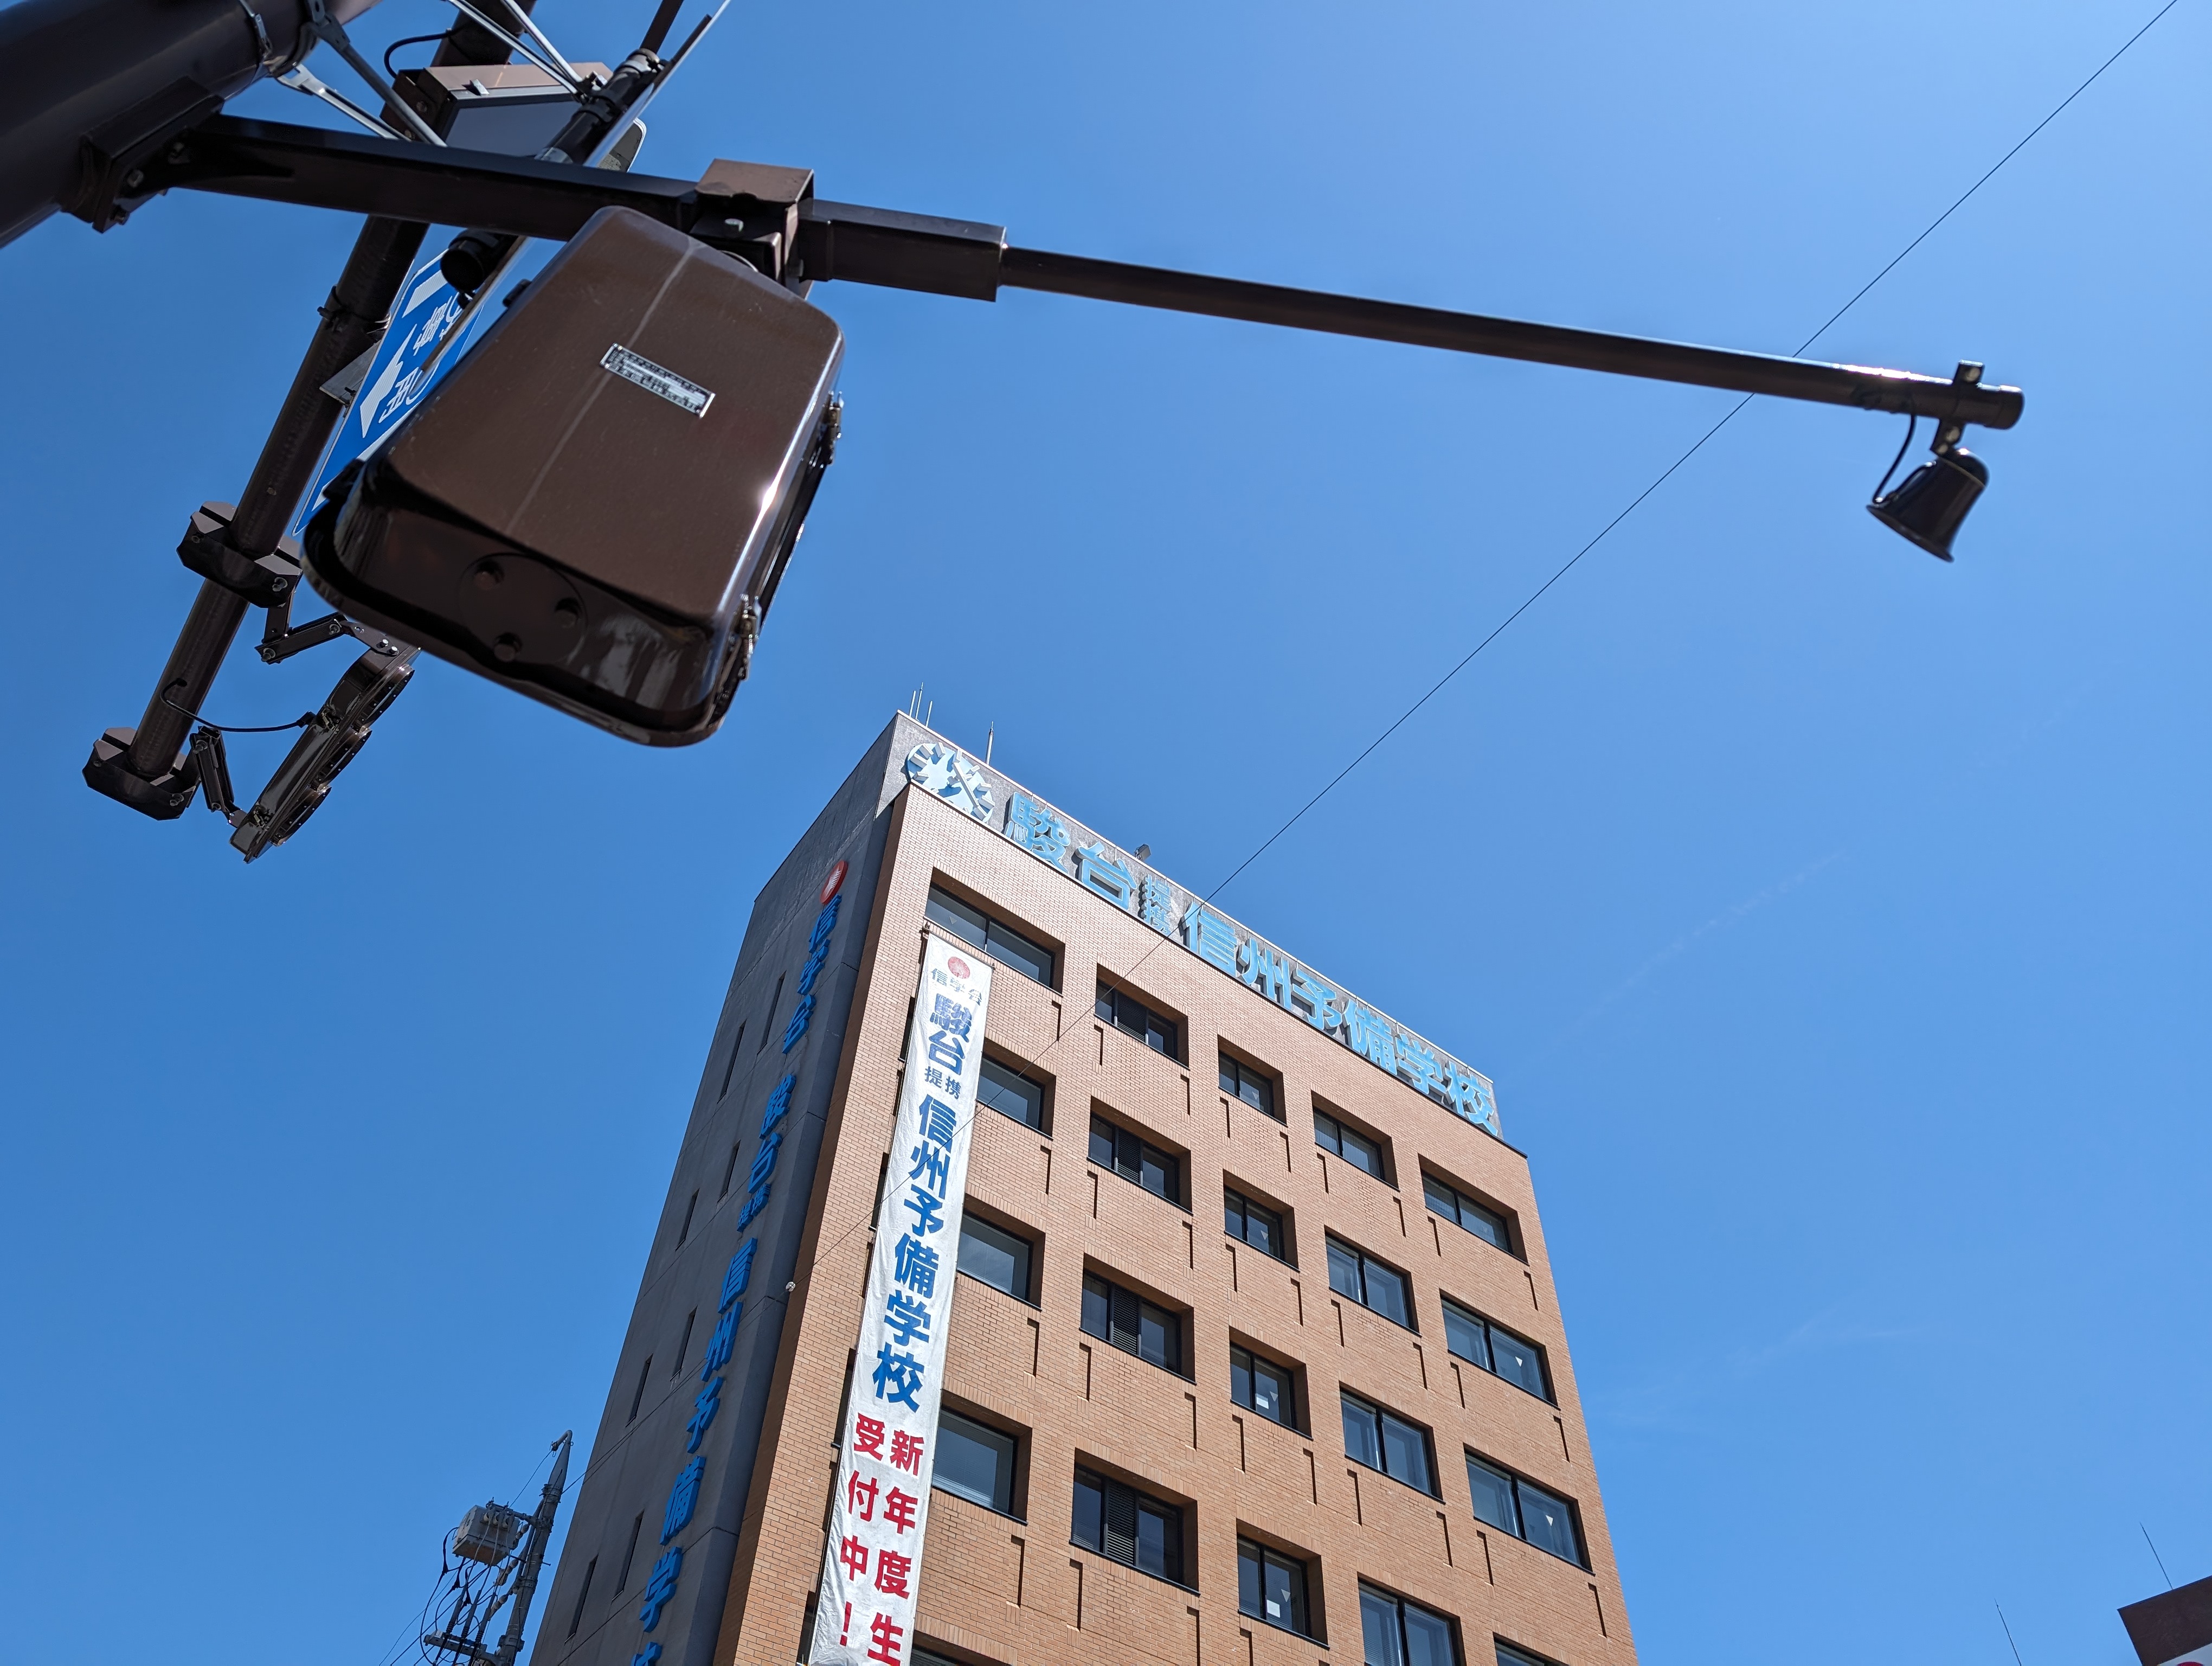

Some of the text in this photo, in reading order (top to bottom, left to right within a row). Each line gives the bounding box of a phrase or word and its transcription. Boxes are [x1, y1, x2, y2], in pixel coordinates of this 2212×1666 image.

[378, 303, 448, 424] 専用
[931, 968, 982, 1006] 信学会
[1005, 791, 1498, 1136] 駿台 提携 信州予備学校
[748, 1073, 796, 1194] 駿台
[872, 993, 973, 1413] 駿台 提携 信州予備学校
[839, 1412, 886, 1647] 受付中！
[867, 1429, 925, 1666] 新年度生
